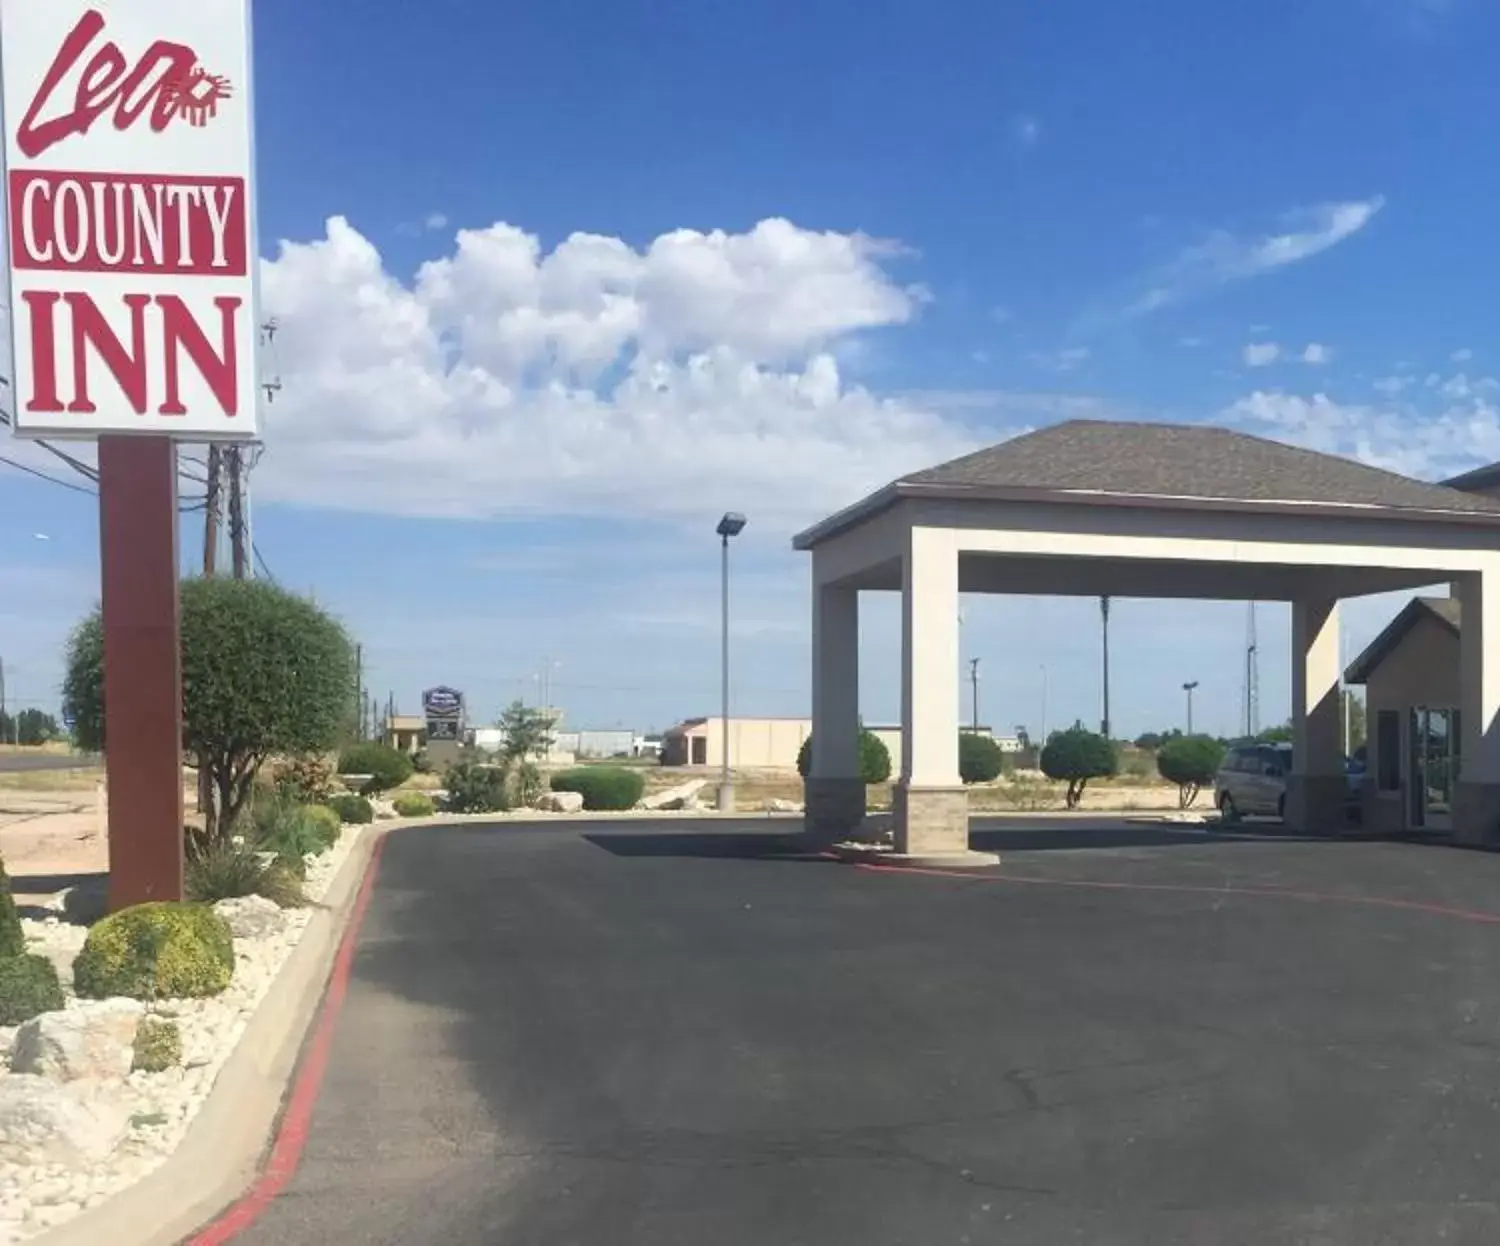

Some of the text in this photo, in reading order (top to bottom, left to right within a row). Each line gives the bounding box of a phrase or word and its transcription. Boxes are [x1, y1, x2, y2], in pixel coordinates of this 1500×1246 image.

[16, 9, 198, 158] Lea
[21, 178, 235, 268] COUNTY
[21, 289, 243, 417] INN
